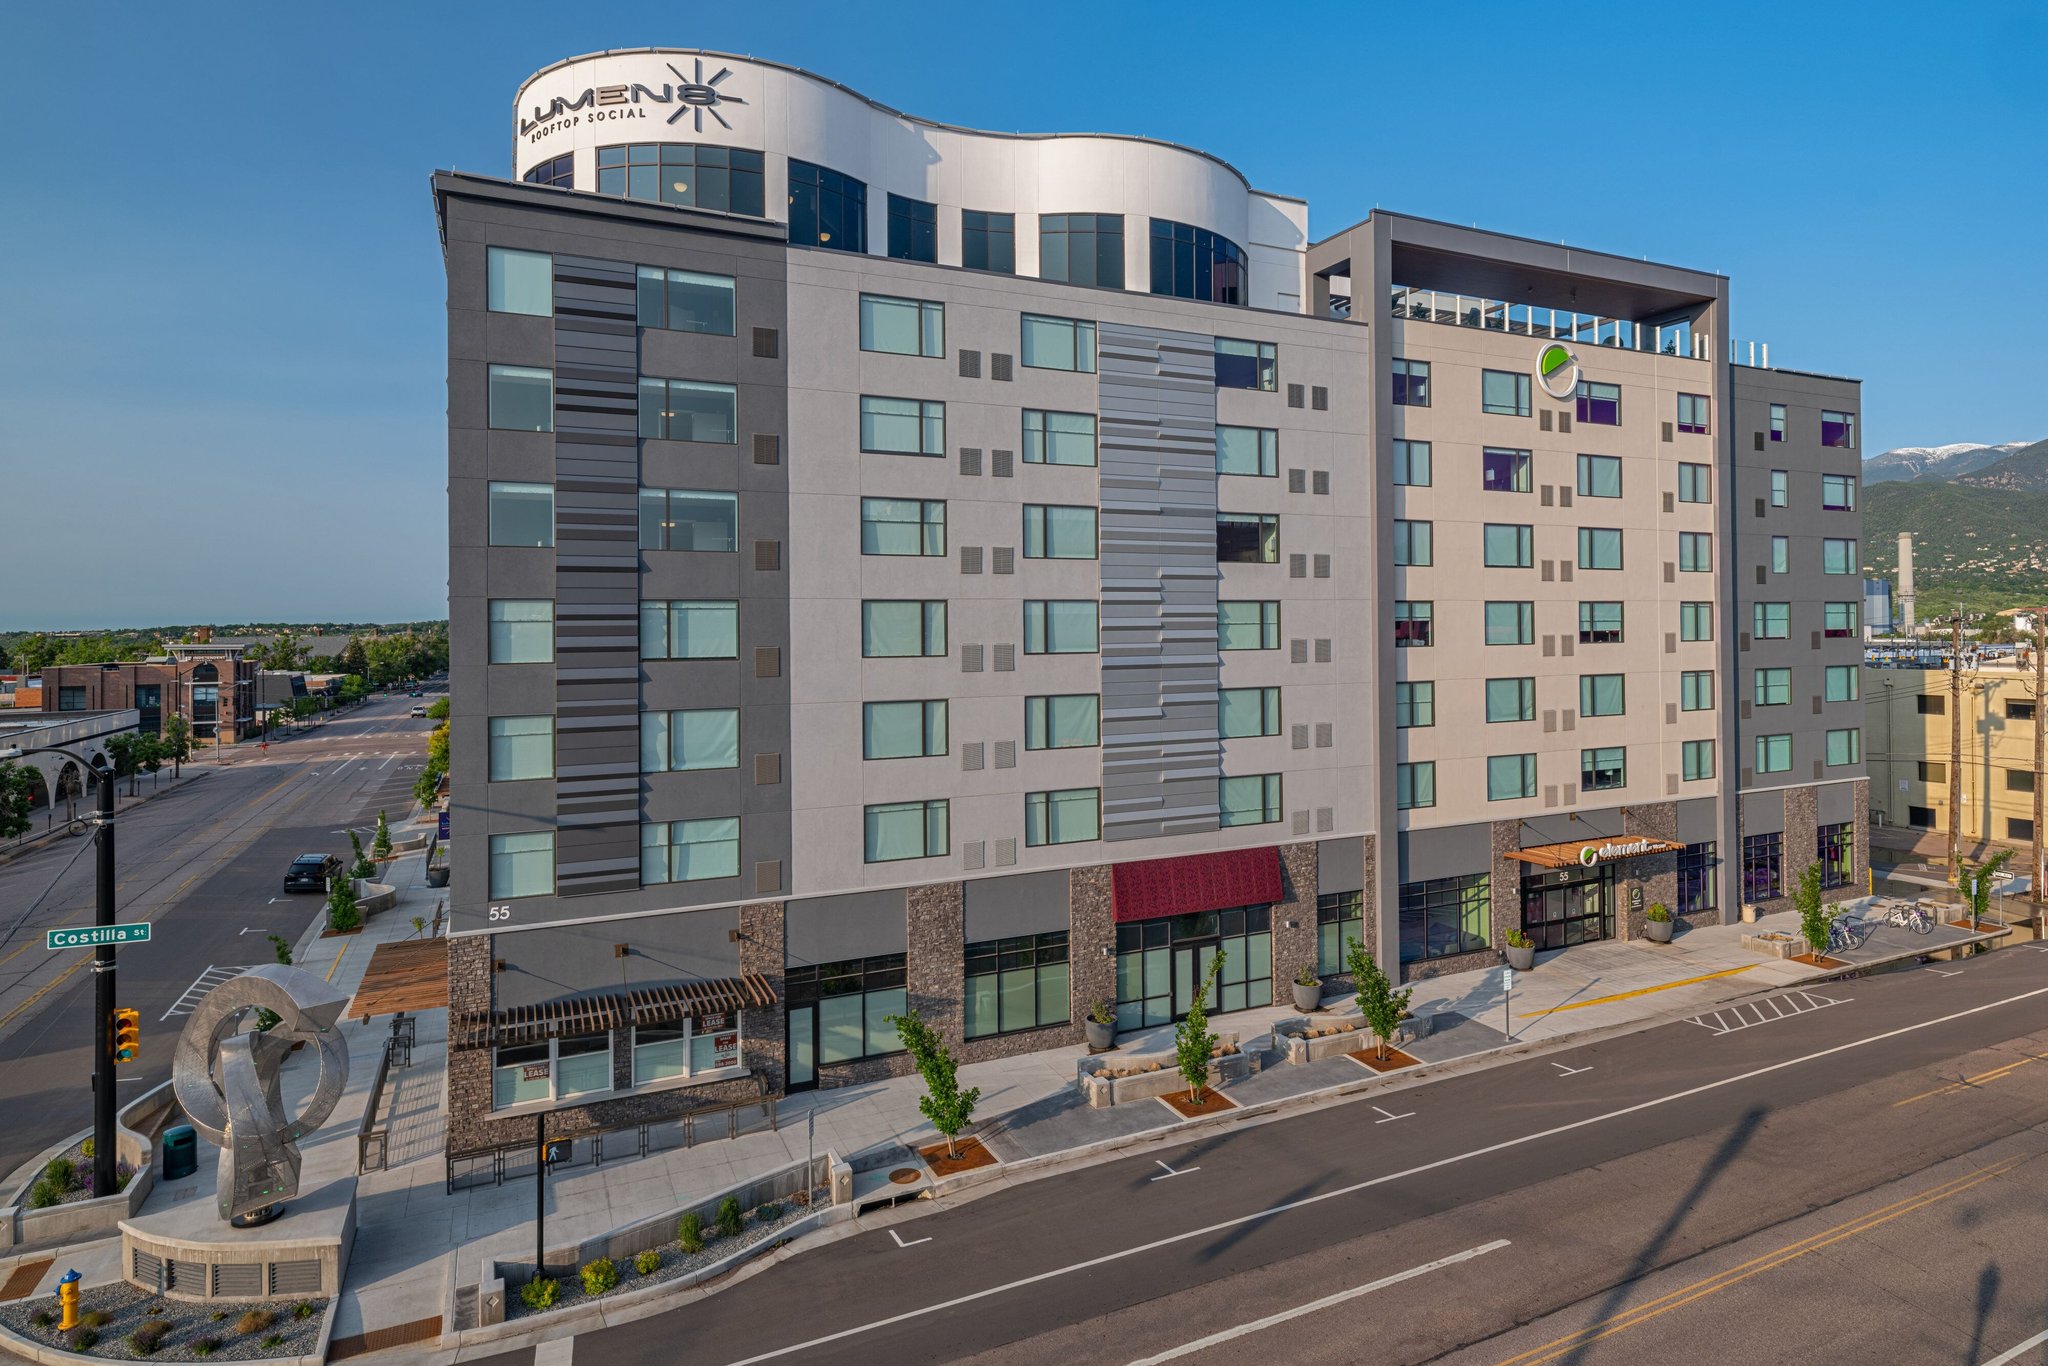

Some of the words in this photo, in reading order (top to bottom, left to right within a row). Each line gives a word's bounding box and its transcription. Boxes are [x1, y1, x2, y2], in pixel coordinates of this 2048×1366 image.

[520, 83, 719, 136] LUMEN8
[531, 116, 580, 144] ROOFTOP
[587, 108, 646, 123] SOCIAL
[1598, 838, 1650, 858] element
[1559, 871, 1569, 882] 55
[488, 905, 511, 921] 55
[53, 928, 127, 946] Costilla
[133, 928, 145, 936] St
[702, 1017, 725, 1028] LEASE
[714, 1042, 738, 1053] LEASE
[524, 1068, 549, 1078] LEASE
